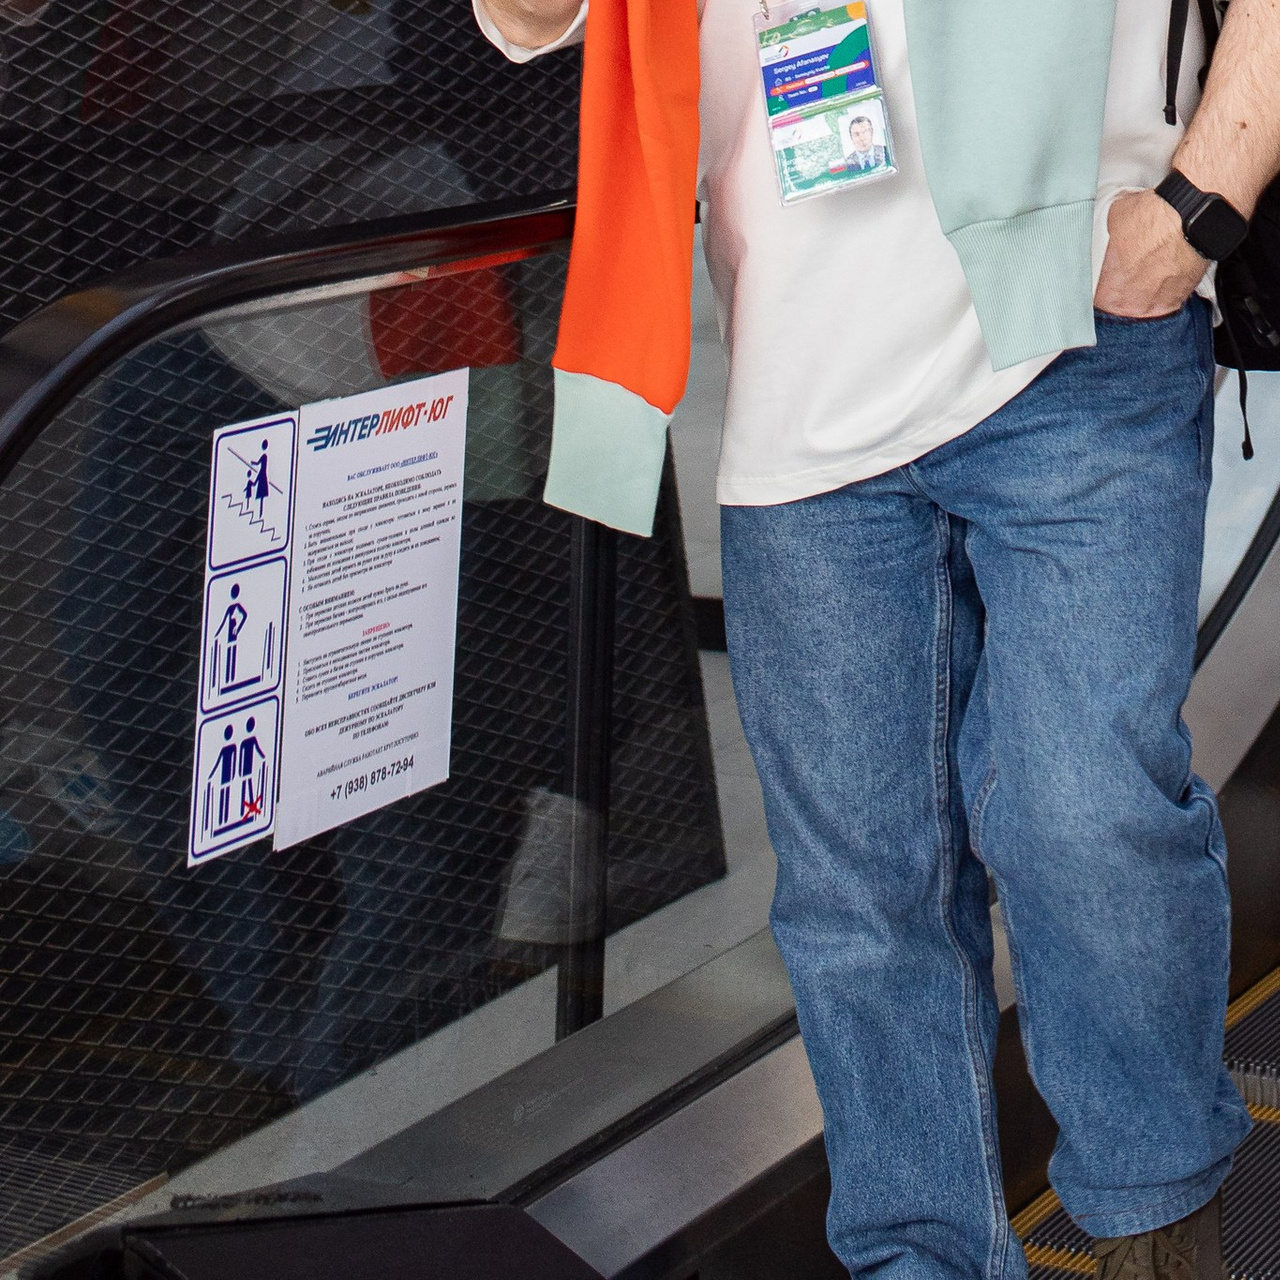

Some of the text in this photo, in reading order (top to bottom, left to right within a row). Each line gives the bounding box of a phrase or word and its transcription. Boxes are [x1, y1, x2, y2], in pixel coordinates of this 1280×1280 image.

[330, 755, 414, 801] +7 (938) 878-72-94
